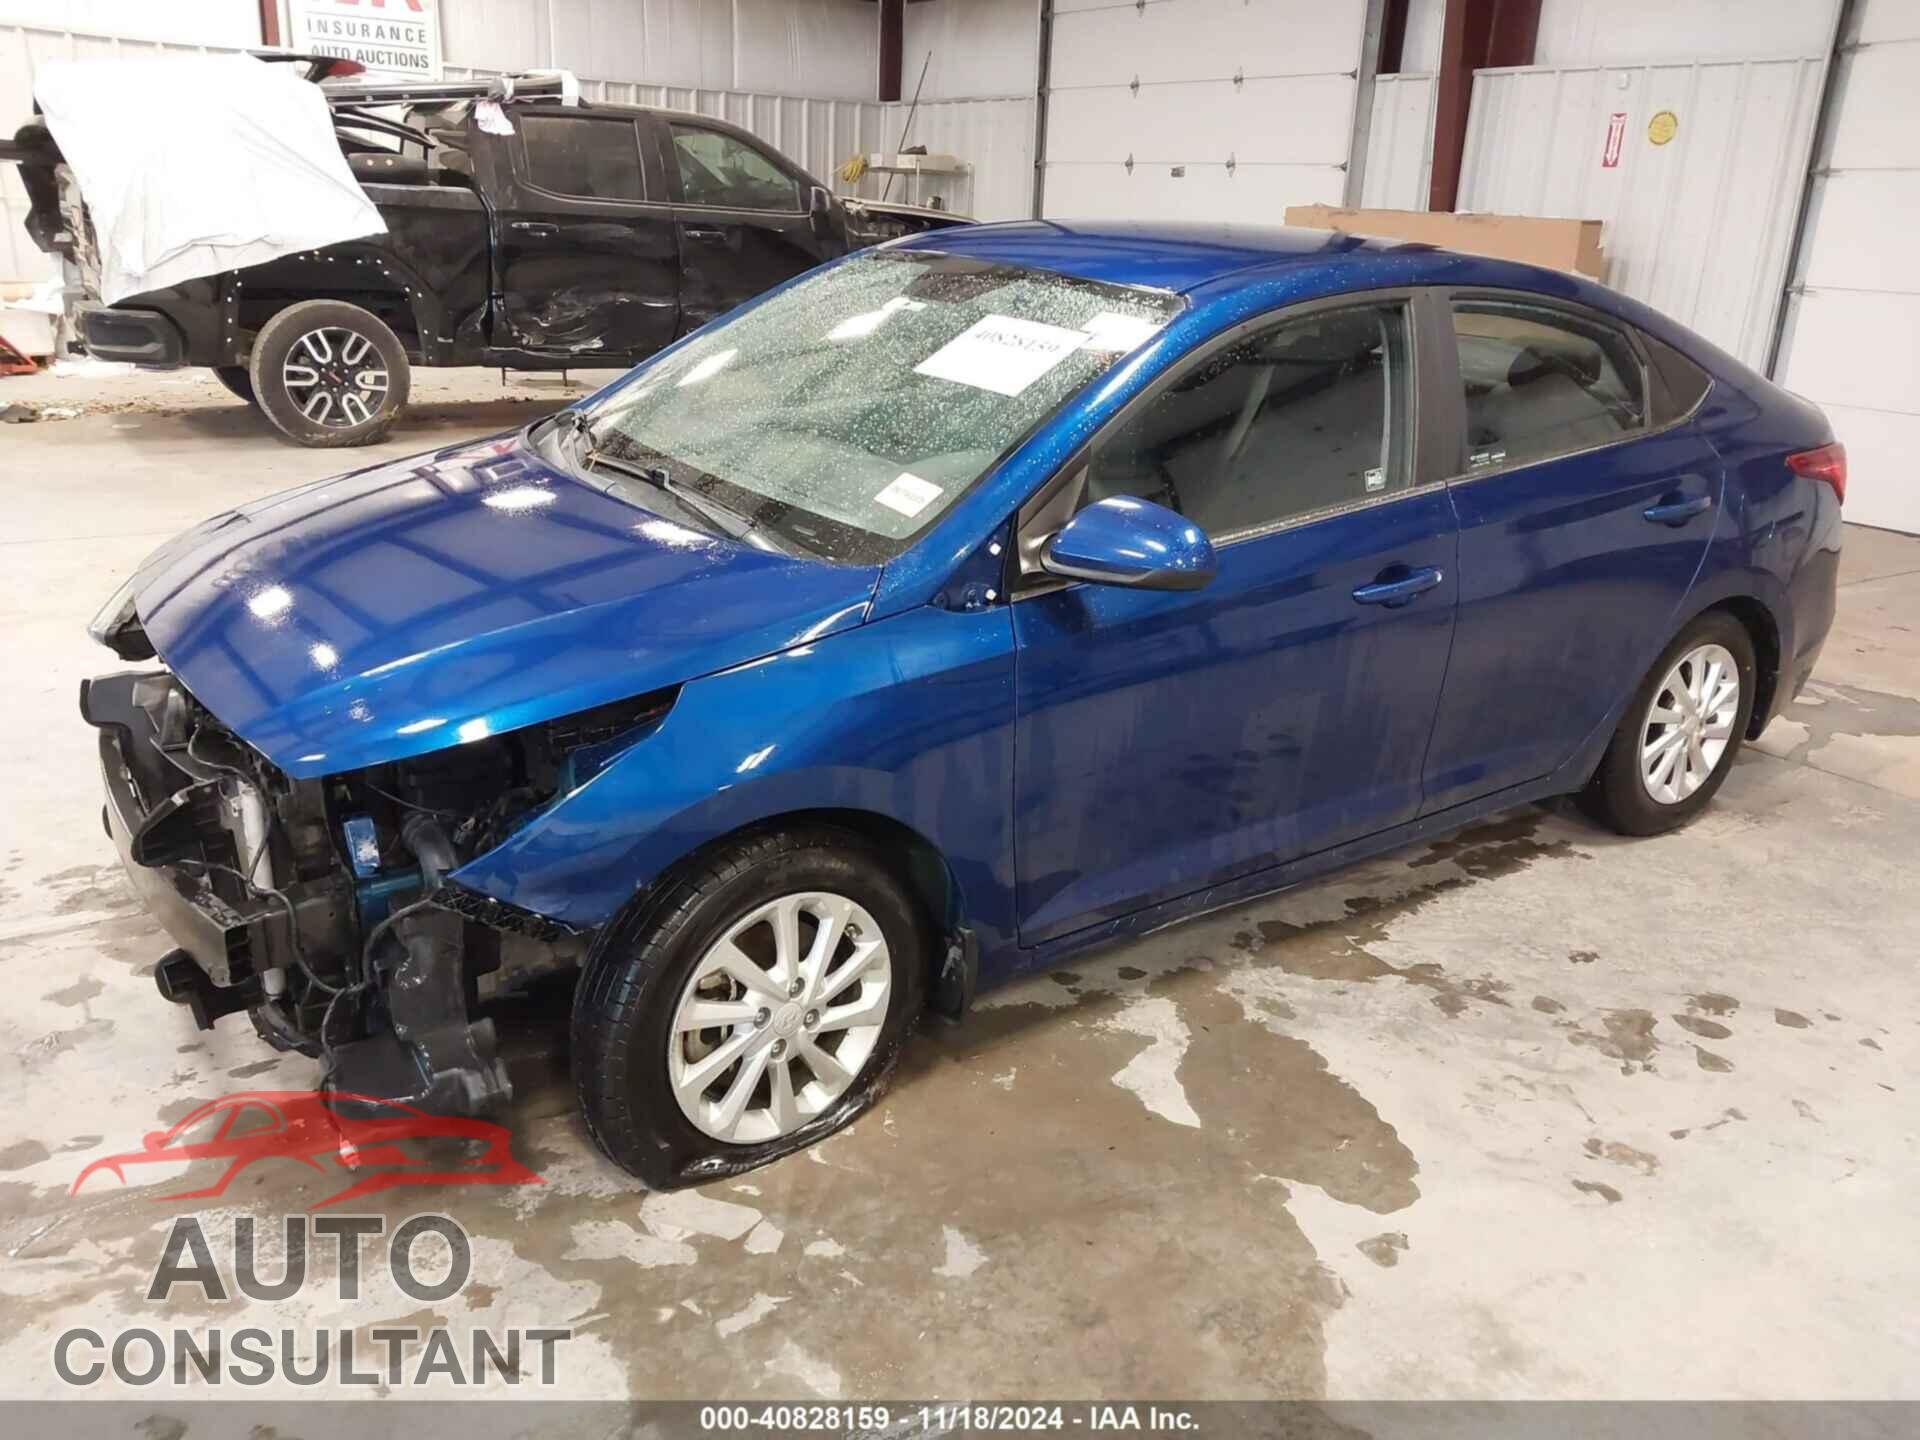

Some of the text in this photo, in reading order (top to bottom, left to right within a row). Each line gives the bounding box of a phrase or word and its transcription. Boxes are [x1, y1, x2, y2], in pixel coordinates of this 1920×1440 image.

[307, 18, 427, 44] INSURANCE
[311, 45, 429, 69] AUTO AUCTIONS
